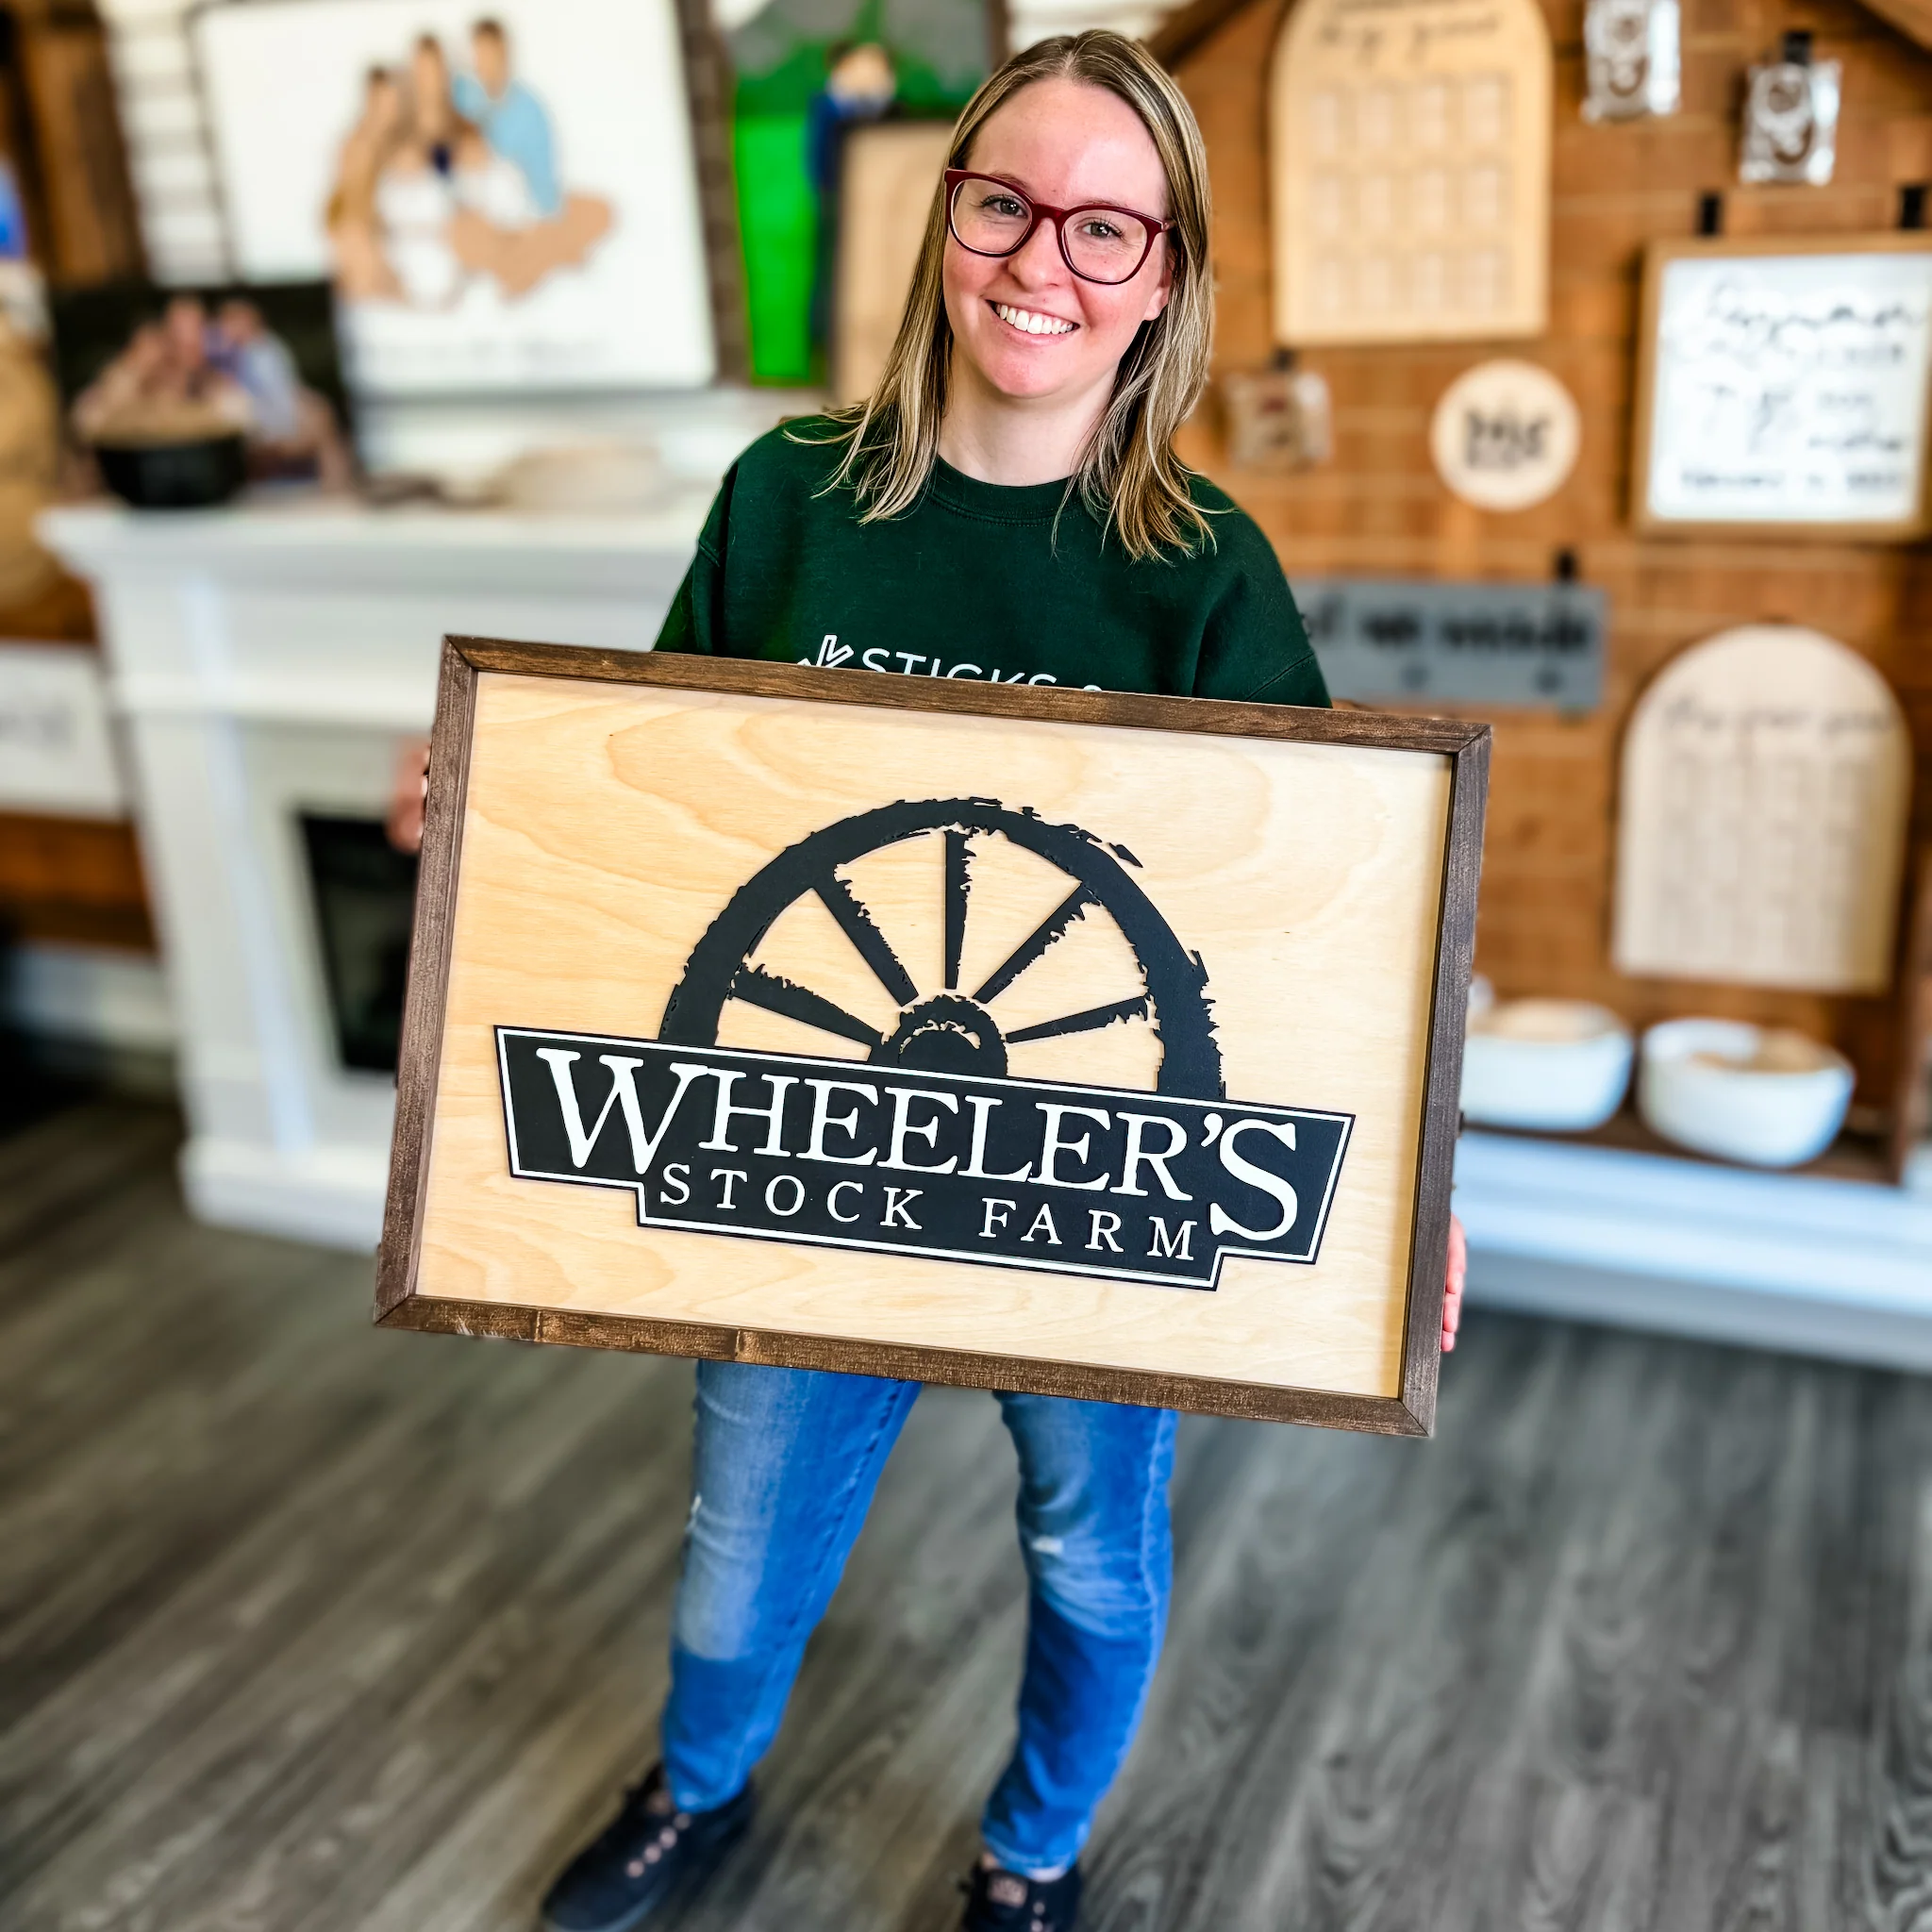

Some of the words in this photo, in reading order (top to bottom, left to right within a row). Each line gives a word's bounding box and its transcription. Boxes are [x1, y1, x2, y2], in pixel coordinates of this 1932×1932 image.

[537, 1048, 1298, 1241] WHEELER'S
[659, 1162, 924, 1230] STOCK
[978, 1197, 1198, 1261] FARM
